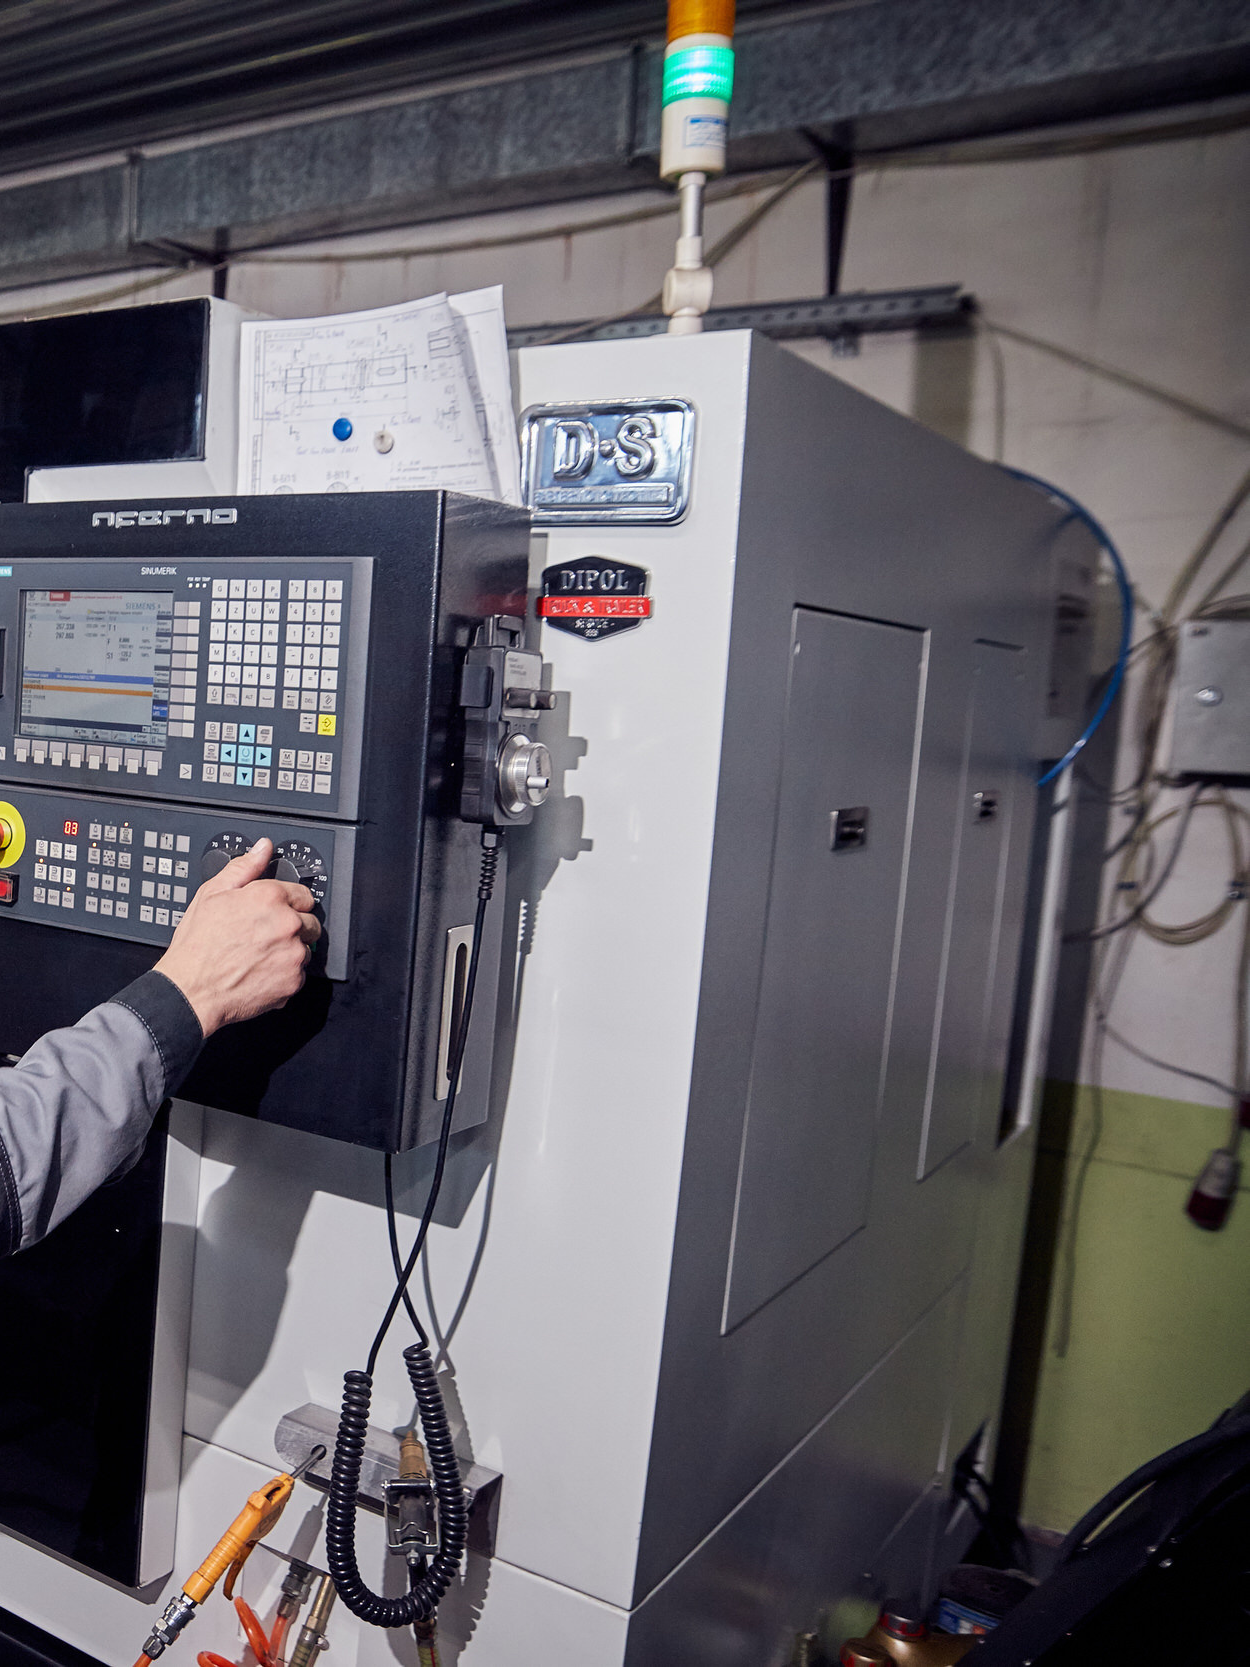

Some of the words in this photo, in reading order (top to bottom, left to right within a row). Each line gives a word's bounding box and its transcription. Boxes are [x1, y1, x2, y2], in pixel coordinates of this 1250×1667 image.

[141, 567, 178, 575] SINUMERIK
[560, 570, 629, 590] DIPOL
[64, 821, 78, 835] 03
